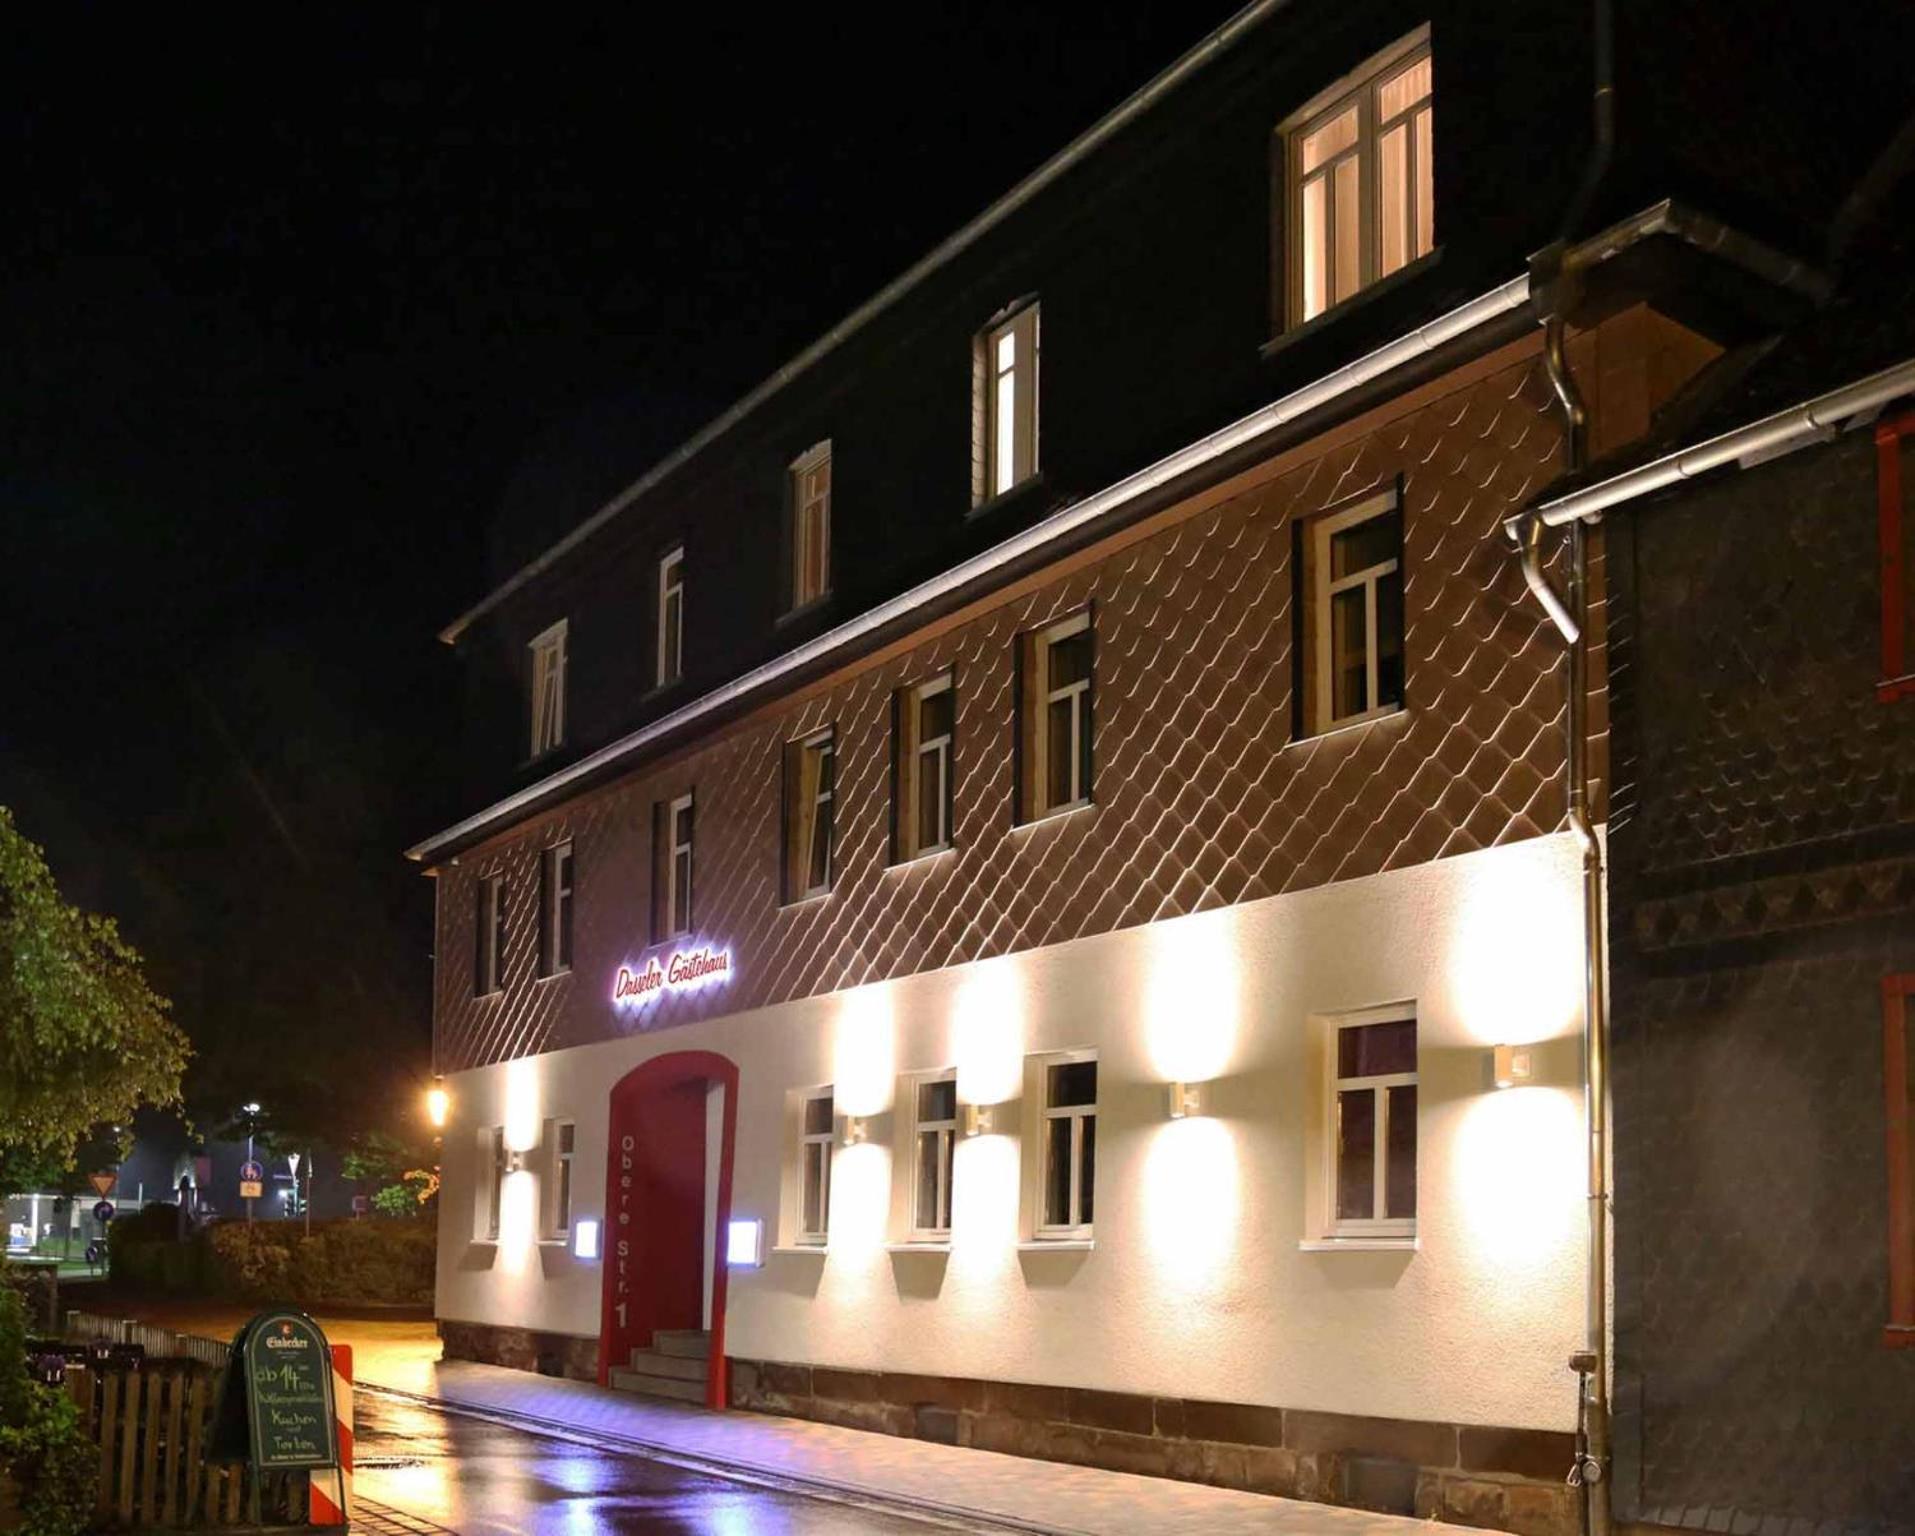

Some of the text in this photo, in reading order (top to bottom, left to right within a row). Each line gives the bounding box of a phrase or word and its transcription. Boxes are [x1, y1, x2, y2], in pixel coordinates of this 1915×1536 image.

[668, 948, 727, 984] Gästehaus
[615, 1135, 635, 1328] Obere Str. 1
[279, 1363, 301, 1391] 14
[271, 1409, 318, 1425] Kuchen
